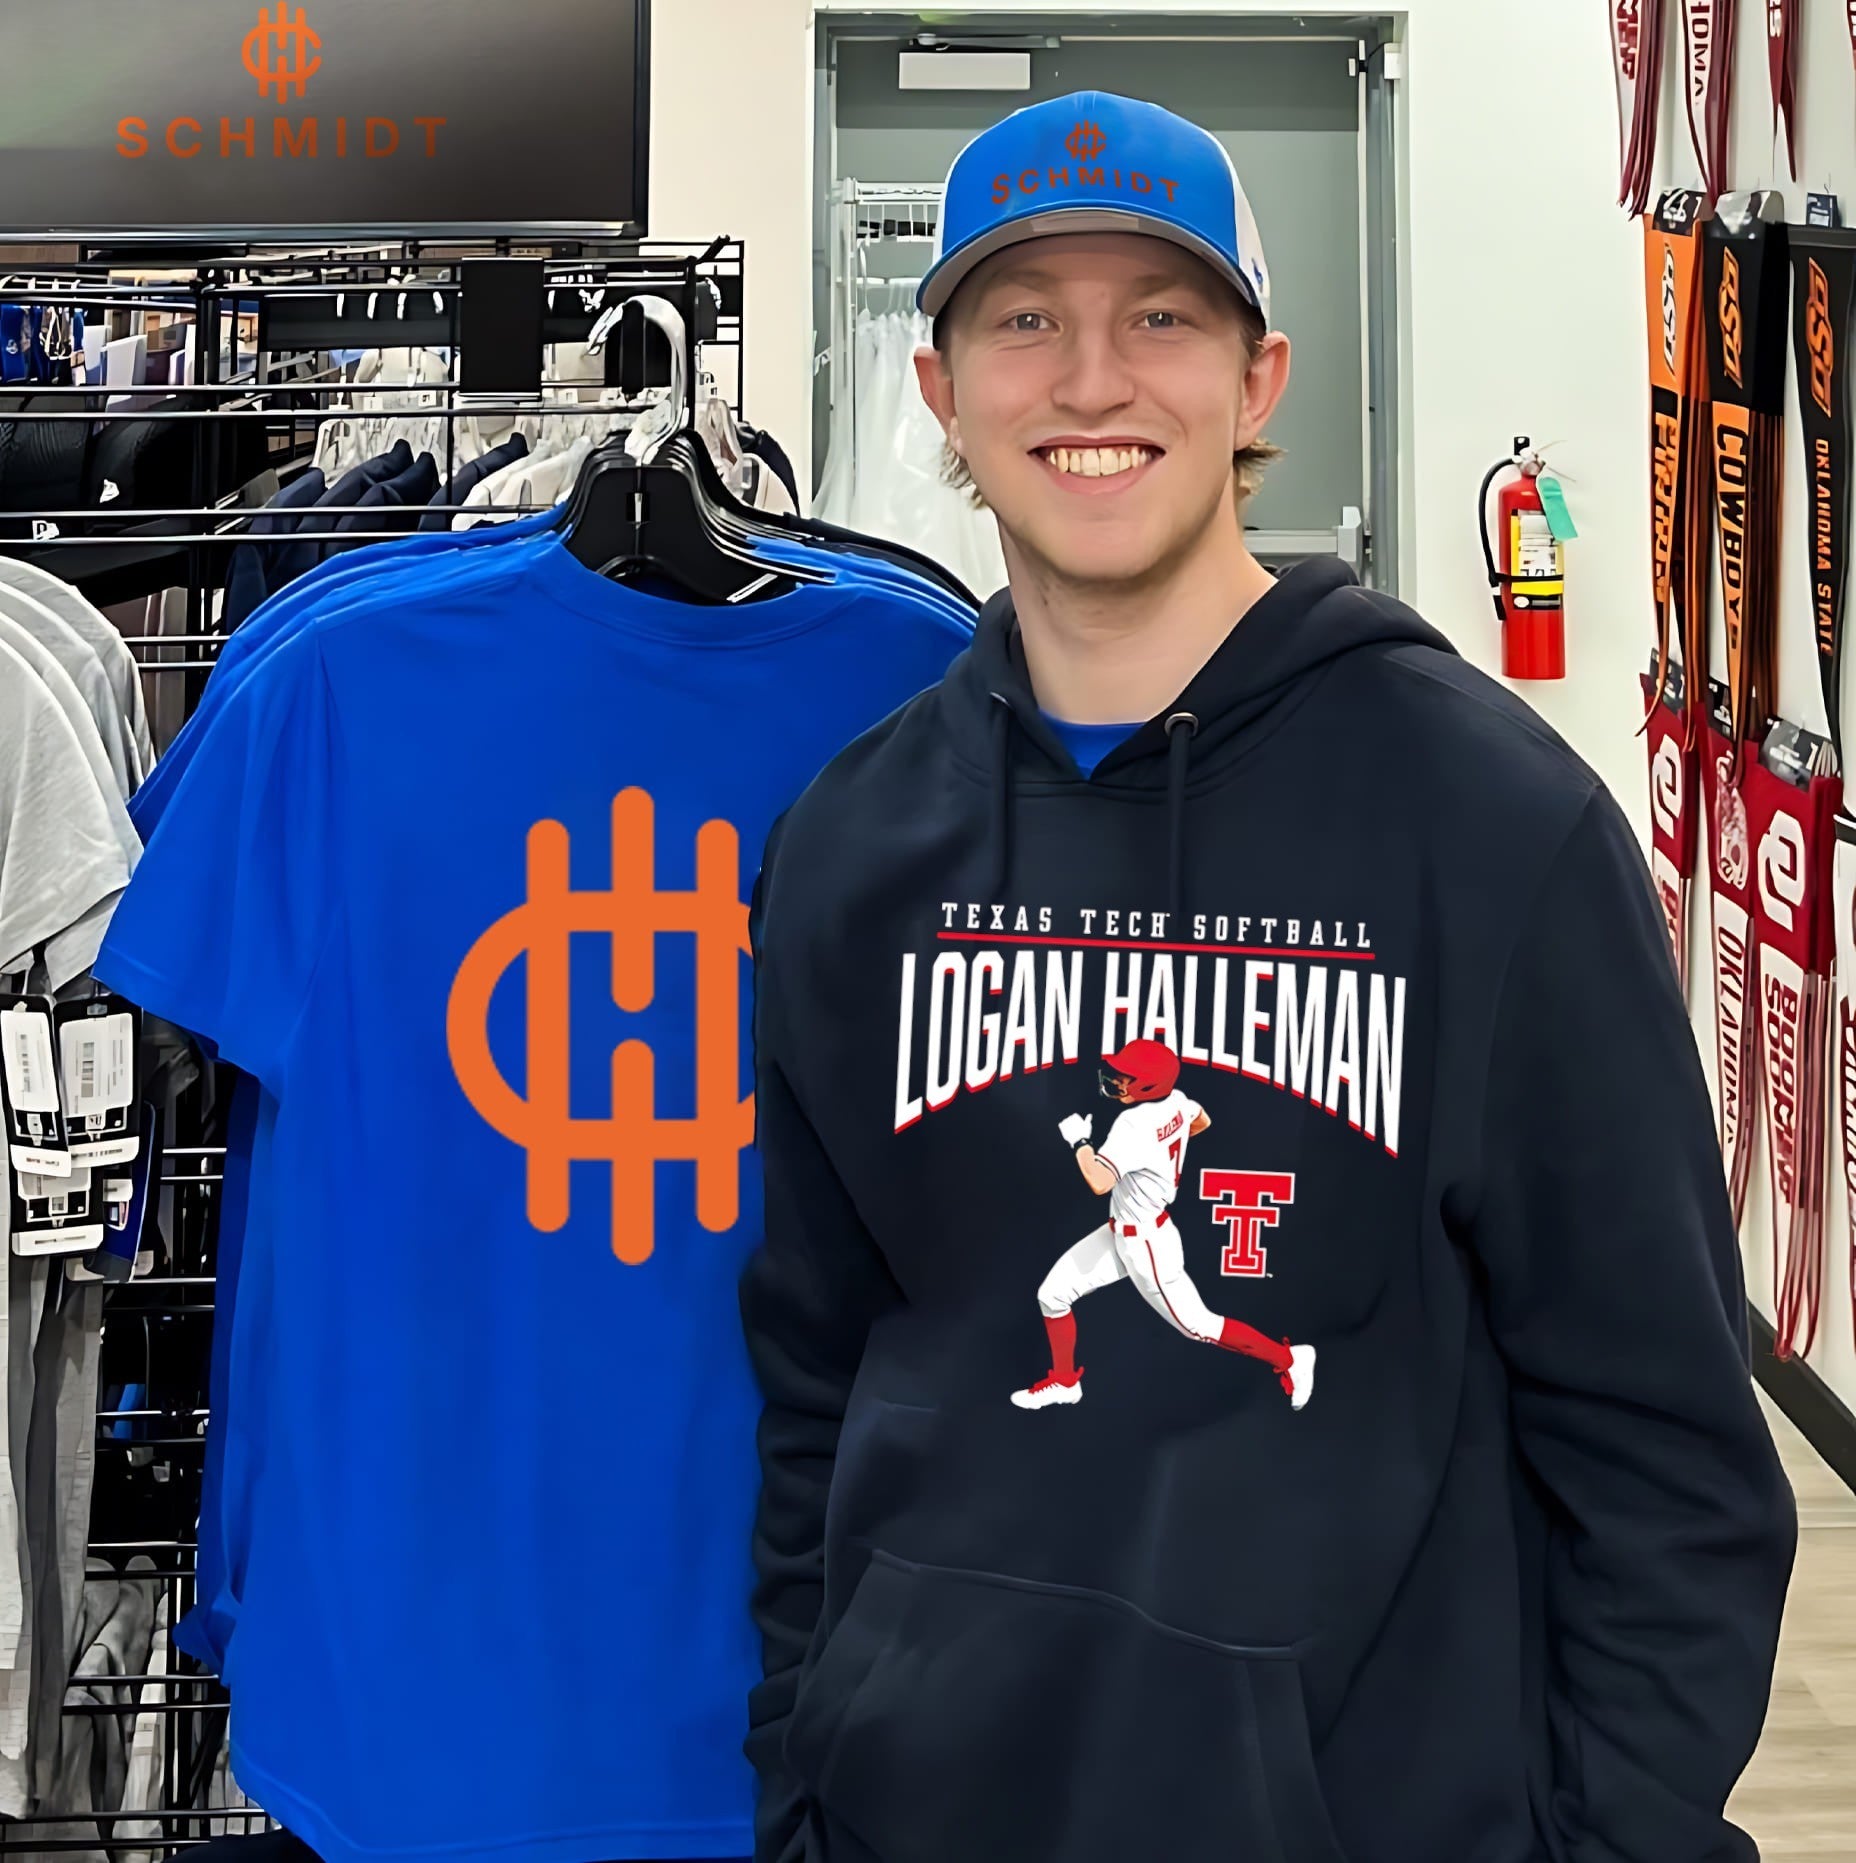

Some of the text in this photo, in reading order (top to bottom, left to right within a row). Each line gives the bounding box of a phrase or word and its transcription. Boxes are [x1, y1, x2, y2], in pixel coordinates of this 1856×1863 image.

[115, 116, 447, 158] SCHMIDT
[991, 167, 1179, 204] SCHMIDT
[1715, 423, 1750, 650] COWBOY
[941, 902, 1371, 949] TEXAS TECH SOFTBALL
[894, 950, 1406, 1159] LOGAN HALLEMAN
